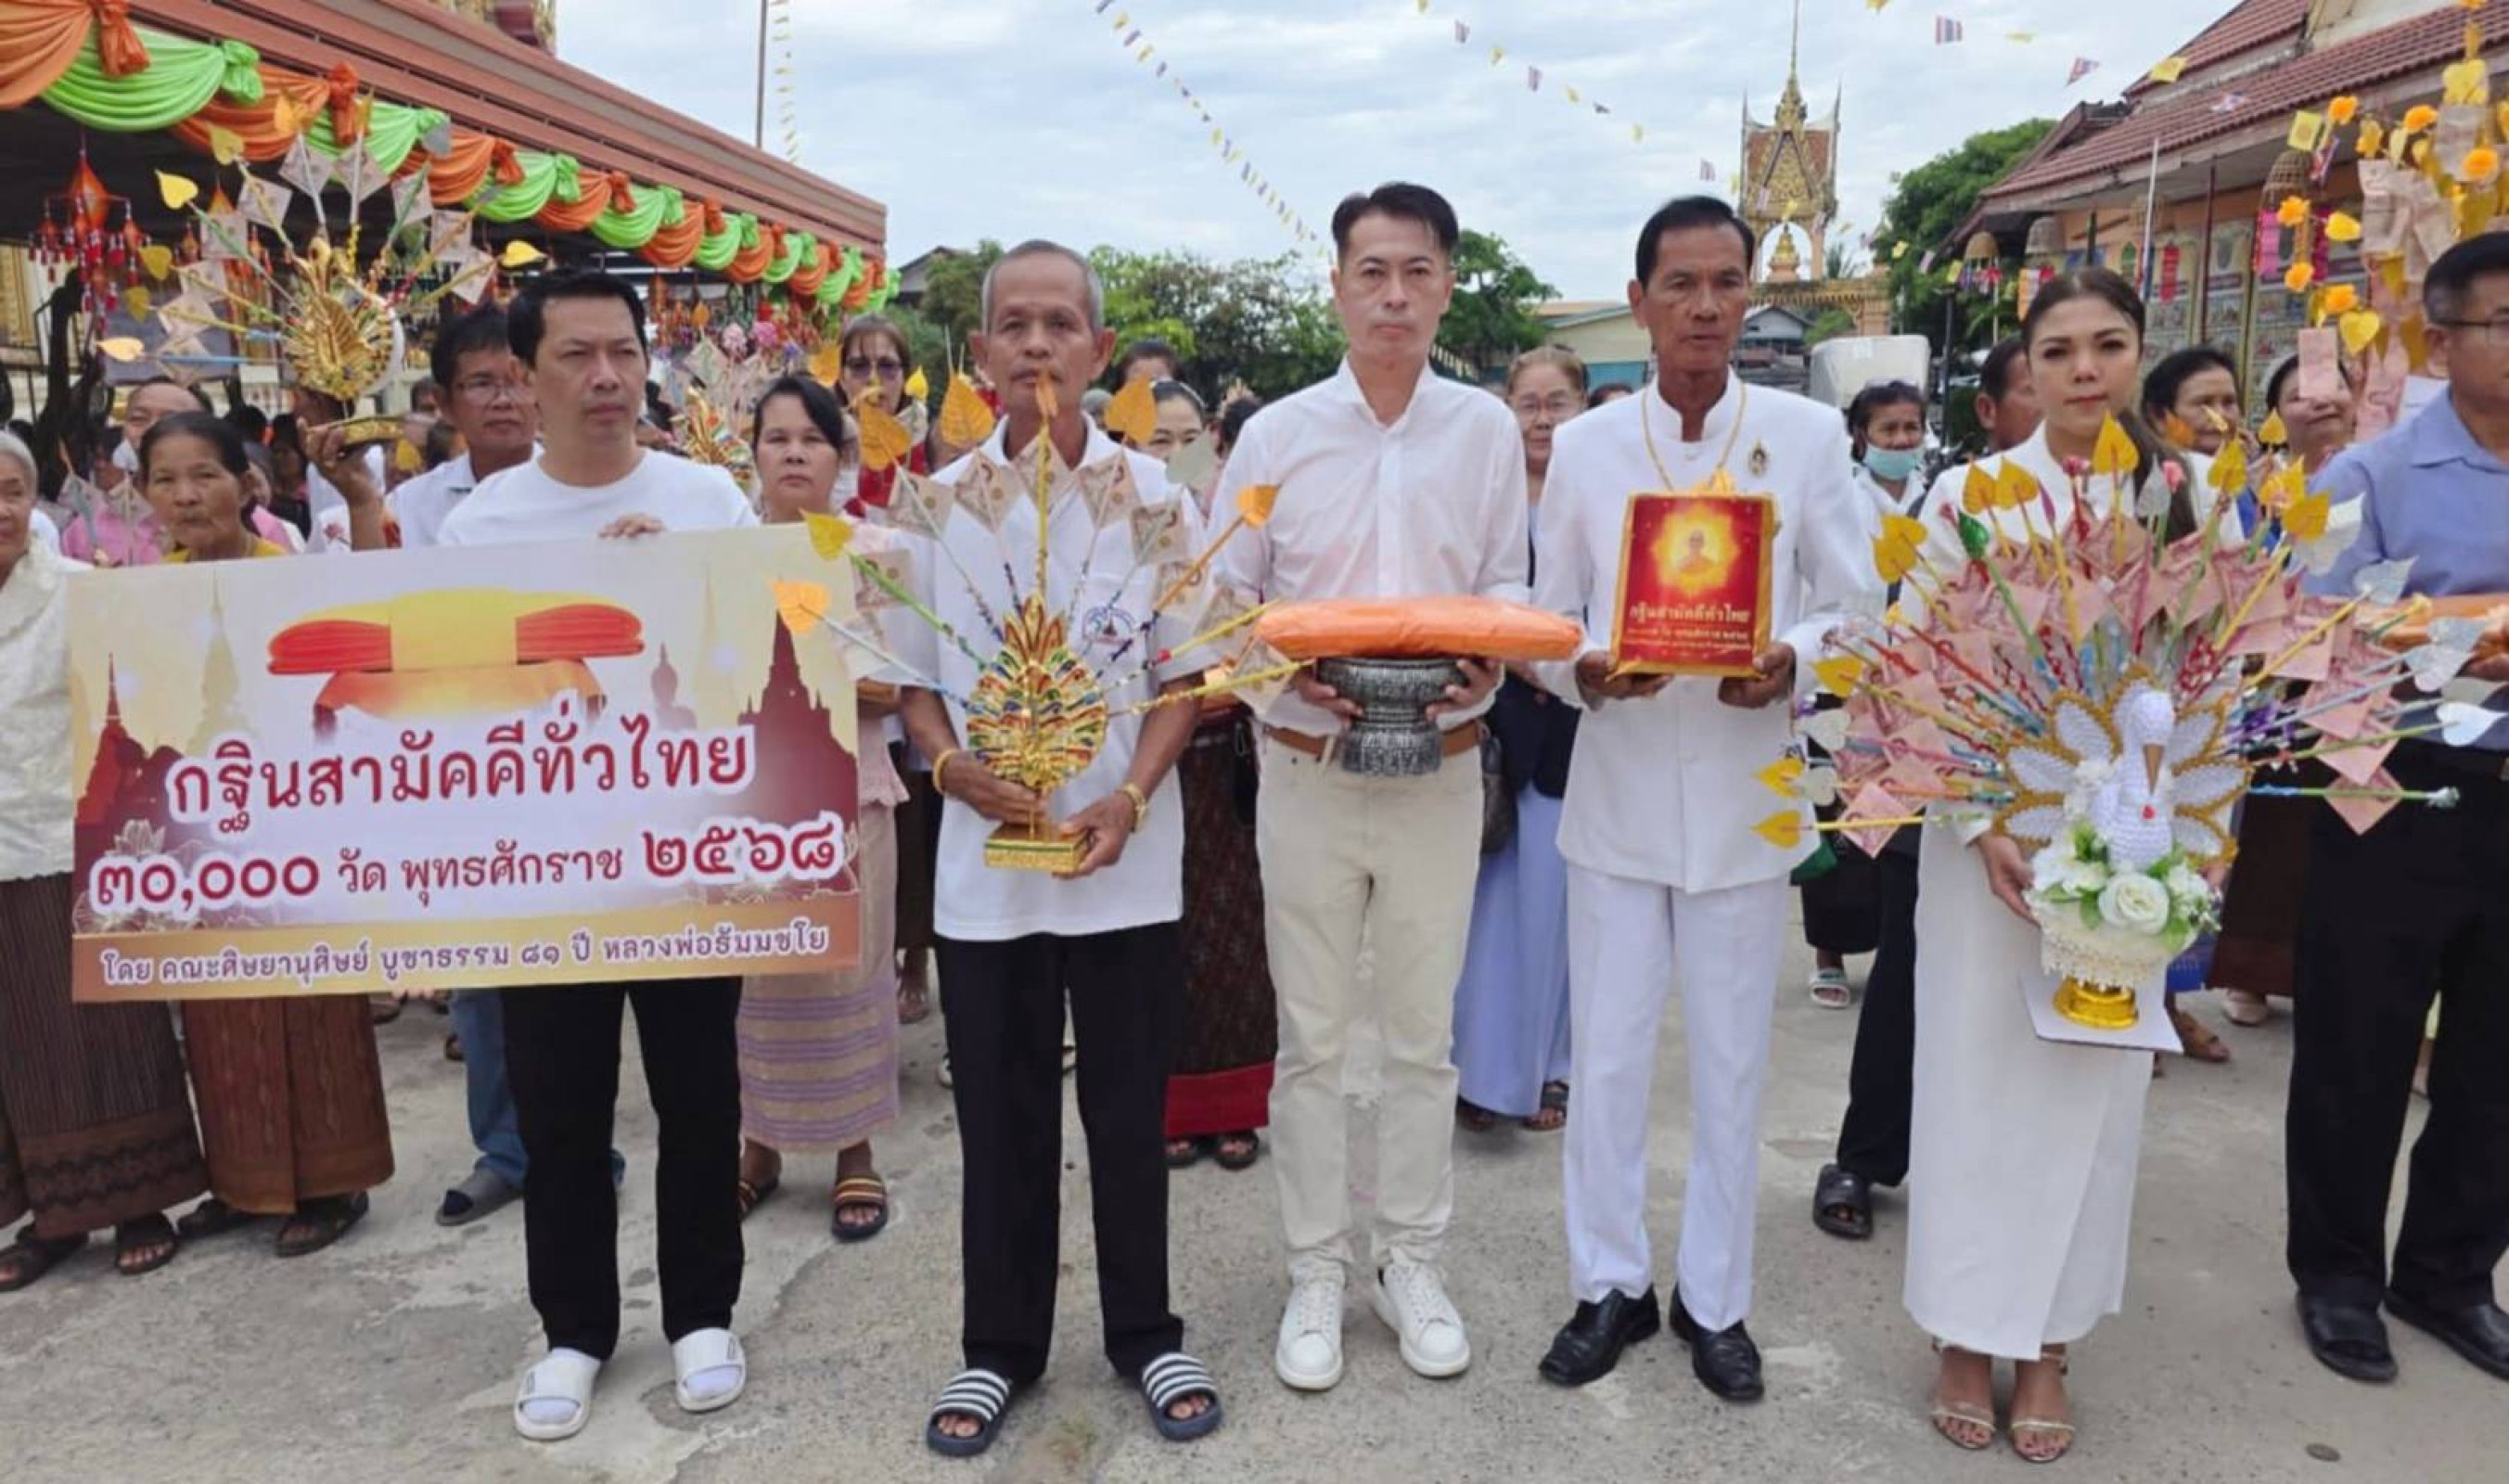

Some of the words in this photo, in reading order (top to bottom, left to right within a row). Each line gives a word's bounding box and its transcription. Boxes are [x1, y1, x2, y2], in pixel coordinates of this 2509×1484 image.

[173, 698, 748, 833] กฐินสามัคคีทั่วไทย
[97, 856, 319, 911] ๓๐,๐๐๐
[338, 847, 387, 892] วัด
[401, 839, 623, 907] พุทธศักราช
[642, 822, 836, 877] ๒๕๖๘
[104, 953, 150, 981] โดย
[162, 940, 369, 984] คณะศิษยานุศิษย์
[381, 944, 509, 980] บูชาธรรม
[520, 944, 560, 966] ๘๑
[571, 931, 591, 962] ปี
[604, 920, 826, 961] หลวงพ่อธัมมชโย
